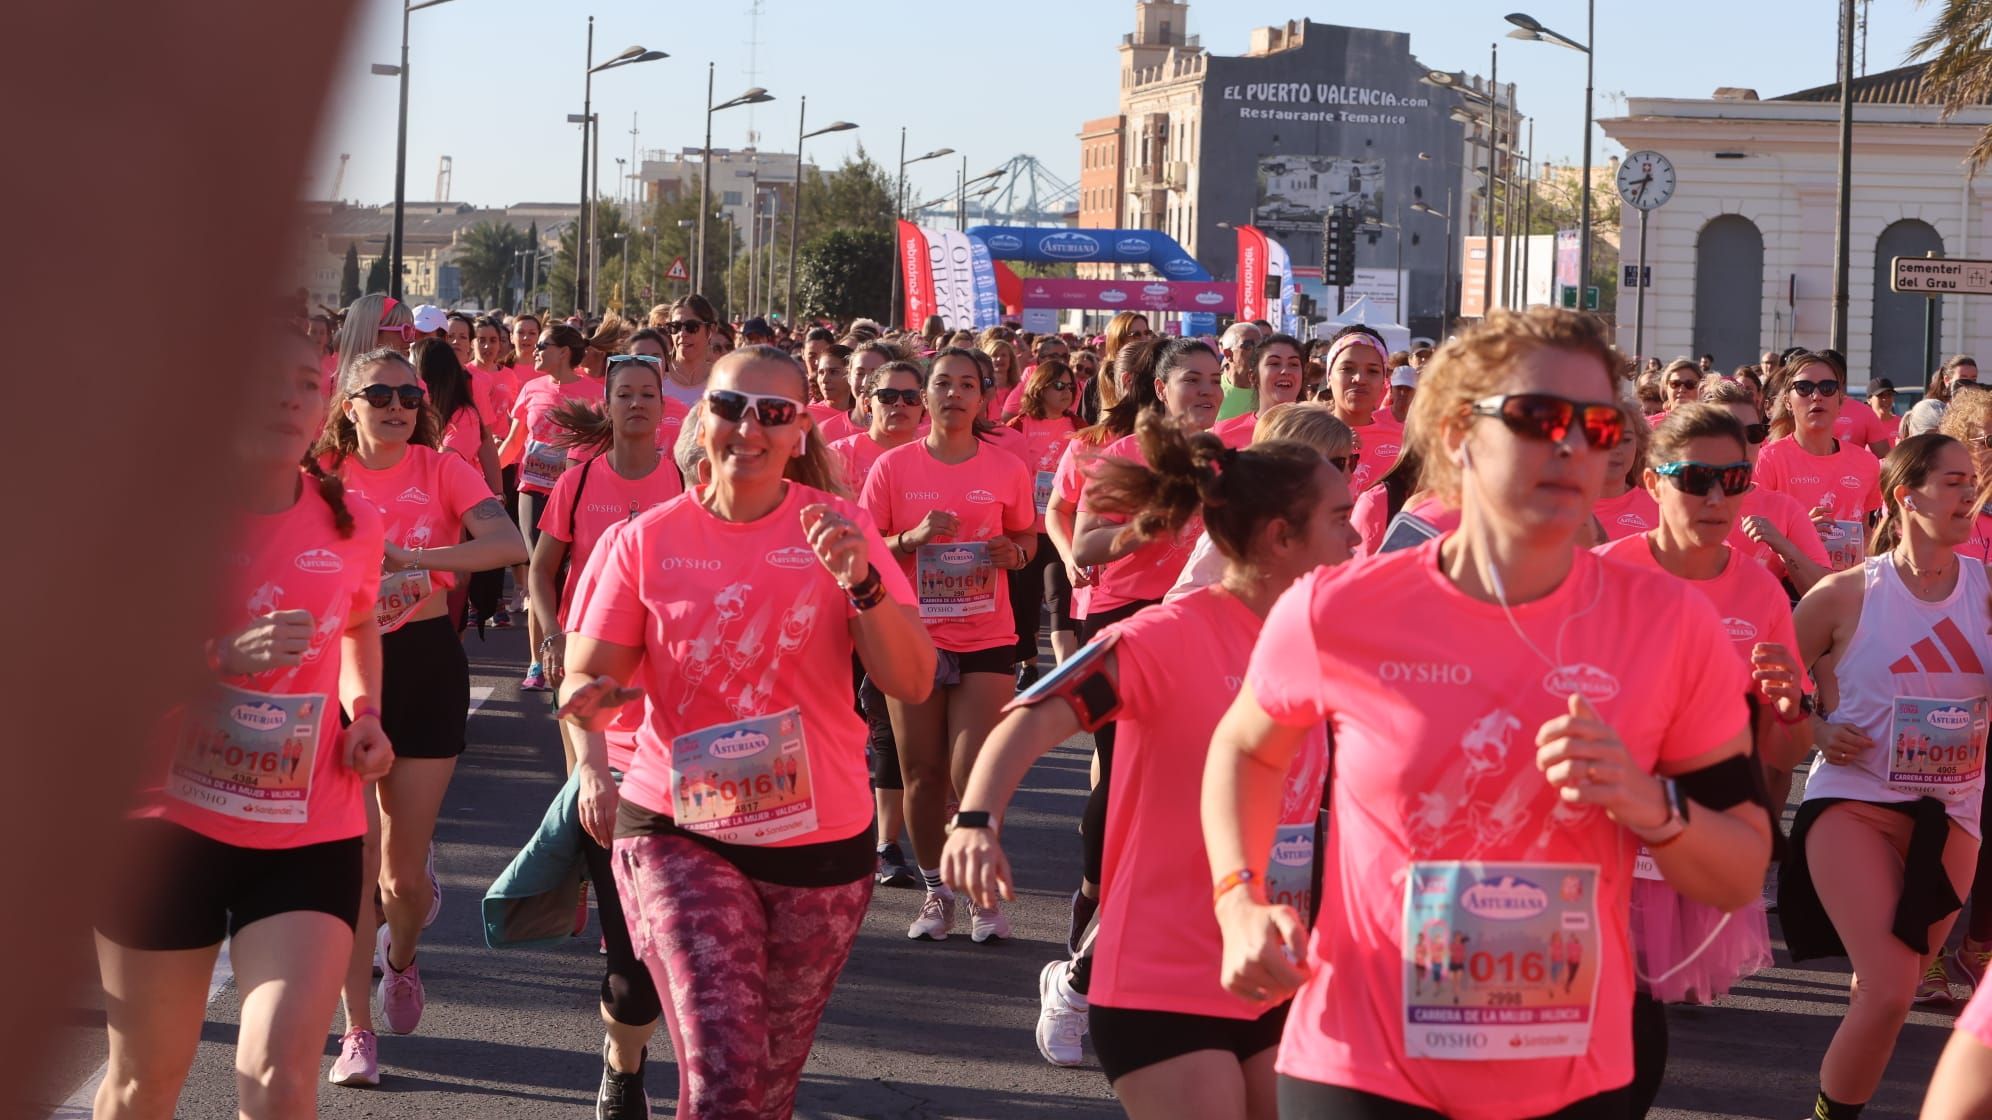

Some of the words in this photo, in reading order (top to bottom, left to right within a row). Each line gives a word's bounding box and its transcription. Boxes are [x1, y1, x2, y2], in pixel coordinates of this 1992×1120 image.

[1224, 86, 1241, 100] EL
[1247, 83, 1311, 103] PUERTO
[1317, 84, 1429, 107] VALENCIA.com
[1240, 107, 1334, 122] Restaurante
[1045, 240, 1094, 253] ASTURIANA
[1899, 264, 1961, 274] cementeri
[1899, 278, 1918, 287] del
[1926, 278, 1956, 288] Grau
[905, 491, 939, 500] OYSHO
[587, 504, 622, 513] OYSHO
[662, 557, 722, 571] OYSHO
[944, 575, 974, 589] 016
[377, 593, 401, 611] 16
[1379, 661, 1473, 686] OYSHO
[713, 739, 767, 756] ASTURIANA
[1929, 745, 1968, 762] 016
[224, 746, 278, 772] 016
[1937, 766, 1957, 774] 4905
[182, 784, 227, 806] OYSHO
[720, 774, 773, 801] 016
[733, 816, 743, 825] LA
[744, 812, 769, 823] MUJER
[775, 801, 807, 814] VALENCIA
[1467, 892, 1544, 908] ASTURIANA
[1470, 952, 1545, 983] 016
[1414, 1008, 1461, 1021] CARRERA
[1463, 1008, 1479, 1022] DE
[1482, 1009, 1498, 1022] LA
[1426, 1032, 1488, 1048] OYSHO
